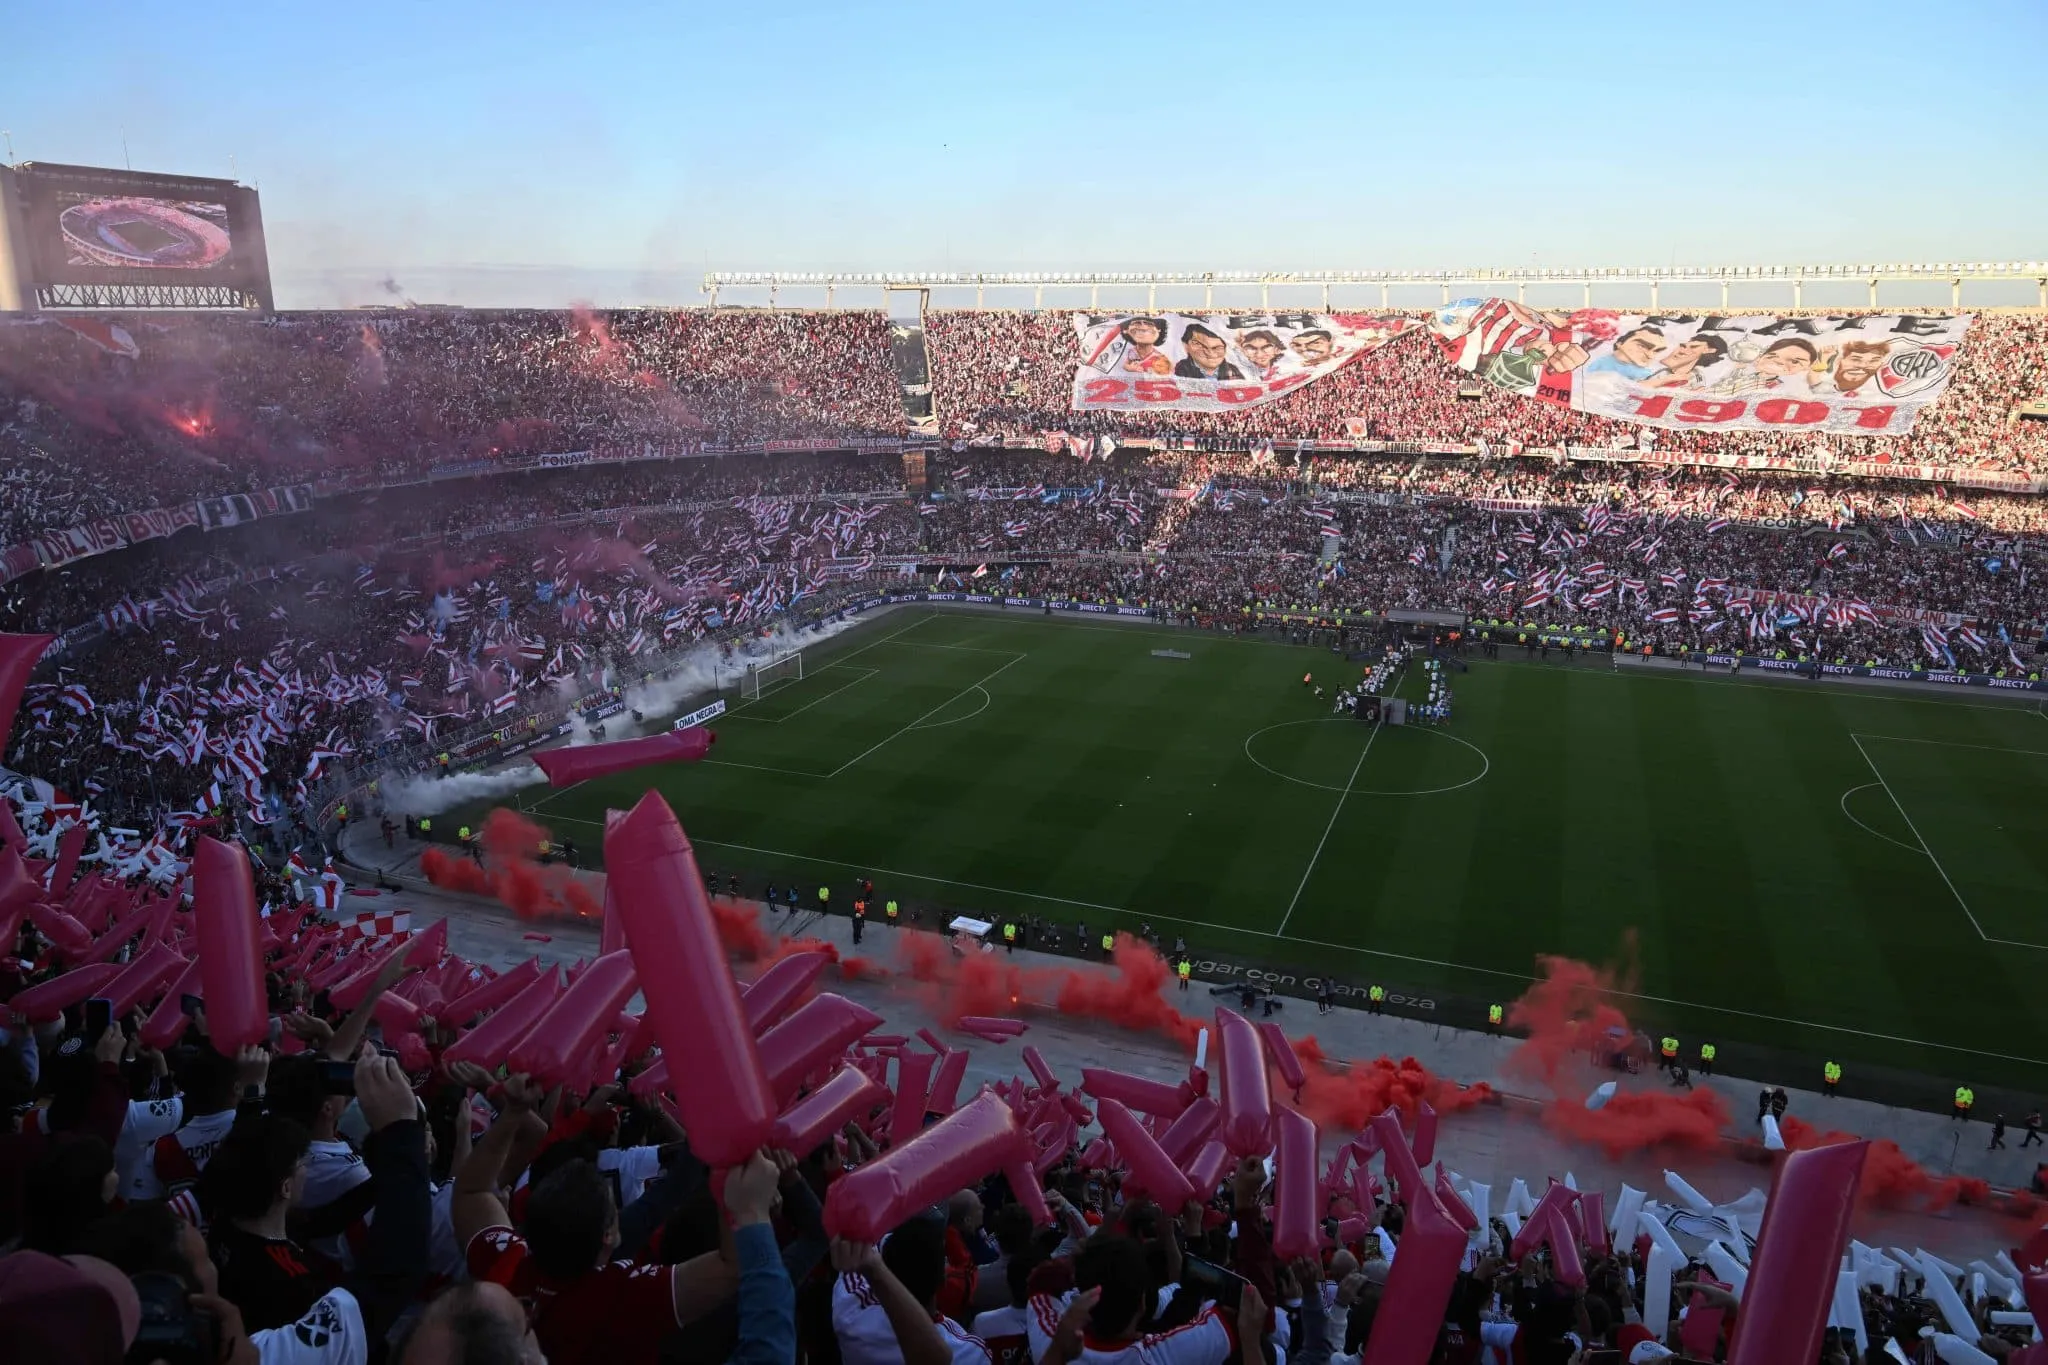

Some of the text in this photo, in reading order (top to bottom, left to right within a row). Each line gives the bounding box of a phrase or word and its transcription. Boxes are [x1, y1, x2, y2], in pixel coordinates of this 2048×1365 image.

[1628, 395, 1899, 428] 1901
[767, 439, 840, 450] BERAZATEGUI
[1385, 443, 1422, 453] LINIERS
[542, 452, 591, 466] FONAVI
[1640, 451, 1719, 464] ADICTO
[1735, 456, 1749, 467] A
[1866, 464, 1922, 478] LUGANO
[1473, 500, 1539, 510] UINQUELA
[1117, 607, 1146, 615] DIRECTV
[1895, 608, 1947, 624] SOLANO
[1706, 655, 1738, 665] DIRECT
[1758, 659, 1798, 670] DIRECTV
[1823, 665, 1854, 674] RECTV
[1869, 667, 1912, 680] DIRECTV
[1927, 673, 1970, 684] DIRECTV
[1988, 678, 2033, 689] DIRECTV
[597, 701, 623, 719] DIRECTV
[675, 705, 717, 730] LOMA NEGRA
[1246, 968, 1296, 985] con
[1303, 978, 1436, 1010] Ganeza
